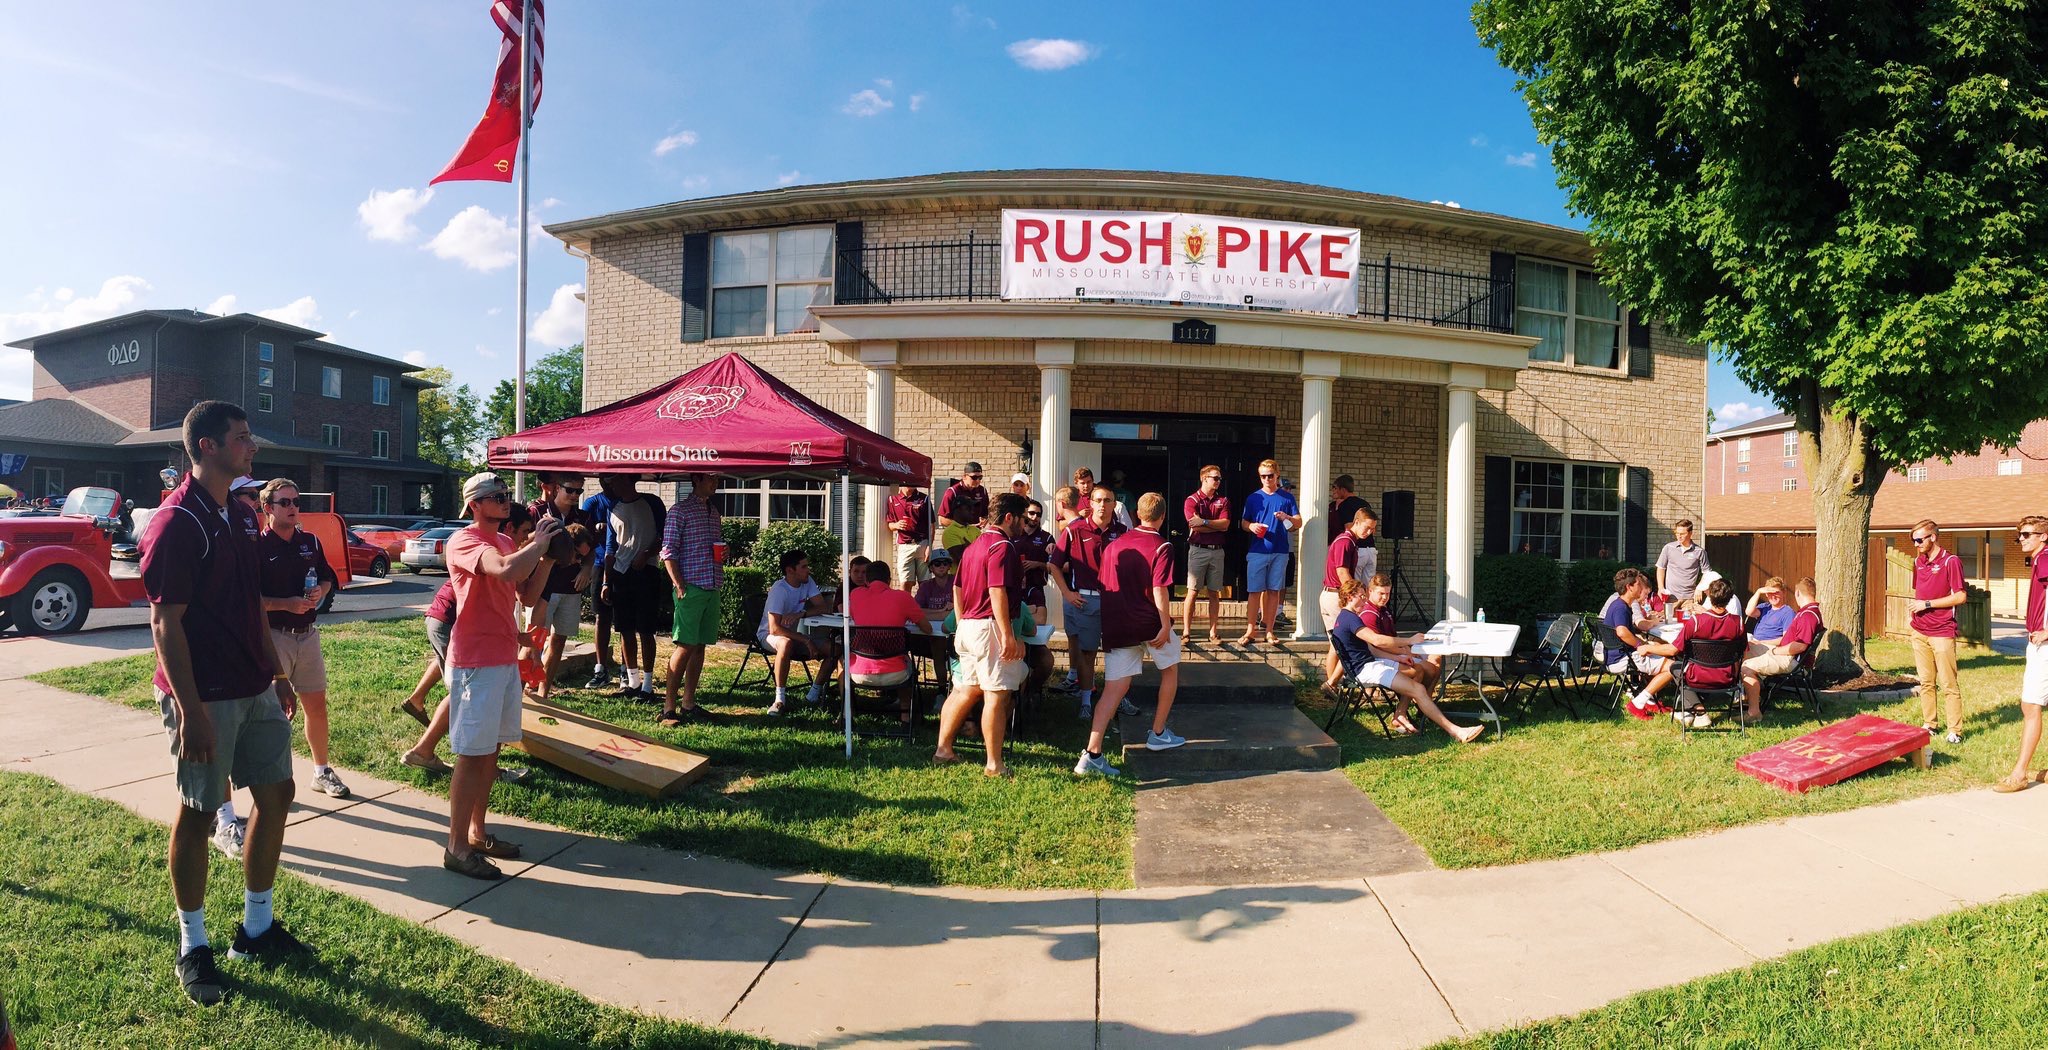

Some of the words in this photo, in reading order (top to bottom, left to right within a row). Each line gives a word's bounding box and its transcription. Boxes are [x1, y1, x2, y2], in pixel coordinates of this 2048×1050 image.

[1015, 219, 1172, 265] RUSH
[1217, 225, 1351, 280] PIKE
[1032, 268, 1130, 279] MISSOURI
[1142, 269, 1200, 283] STATE
[1213, 274, 1331, 291] UNIVERSITY
[1179, 327, 1209, 340] 1117
[107, 339, 140, 366] ΦΔΘ
[586, 444, 667, 463] Missouri
[669, 444, 719, 463] State
